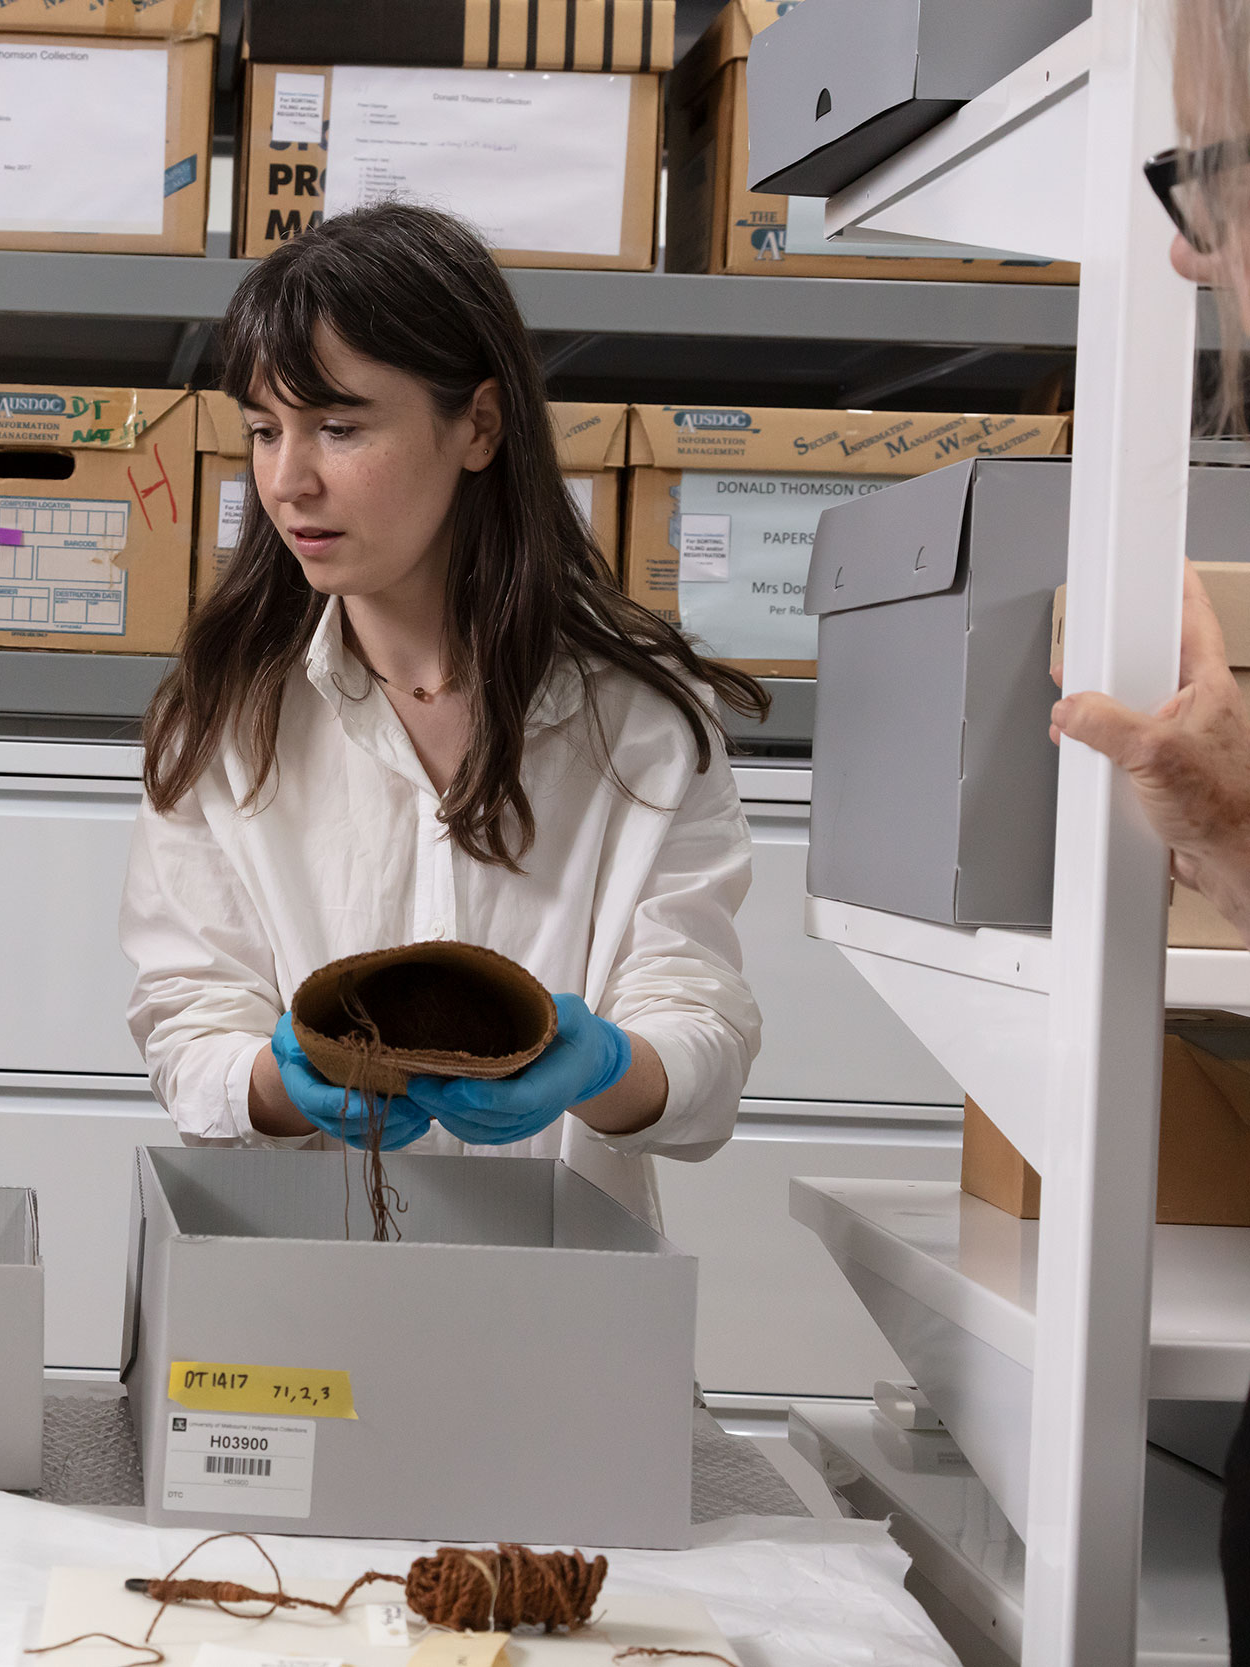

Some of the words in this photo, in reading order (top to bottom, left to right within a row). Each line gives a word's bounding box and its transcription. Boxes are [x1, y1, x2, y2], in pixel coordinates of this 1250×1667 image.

[40, 50, 89, 61] Collection
[433, 93, 459, 102] Donald
[750, 211, 777, 222] THE
[70, 396, 110, 419] DT
[676, 412, 747, 434] AUSDOC
[677, 436, 746, 445] INFORMATION
[677, 447, 746, 456] MANAGEMENT
[717, 481, 776, 494] DONALD
[780, 483, 854, 496] THOMSON
[0, 500, 37, 508] COMPUTER
[763, 532, 816, 545] PAPERS
[64, 540, 97, 548] BARCODE
[752, 582, 779, 594] Mrs
[55, 591, 101, 599] DESTRUCTION
[102, 592, 121, 600] DATE
[770, 606, 787, 615] Per
[210, 1435, 269, 1451] H03900
[168, 1491, 184, 1499] DTC
